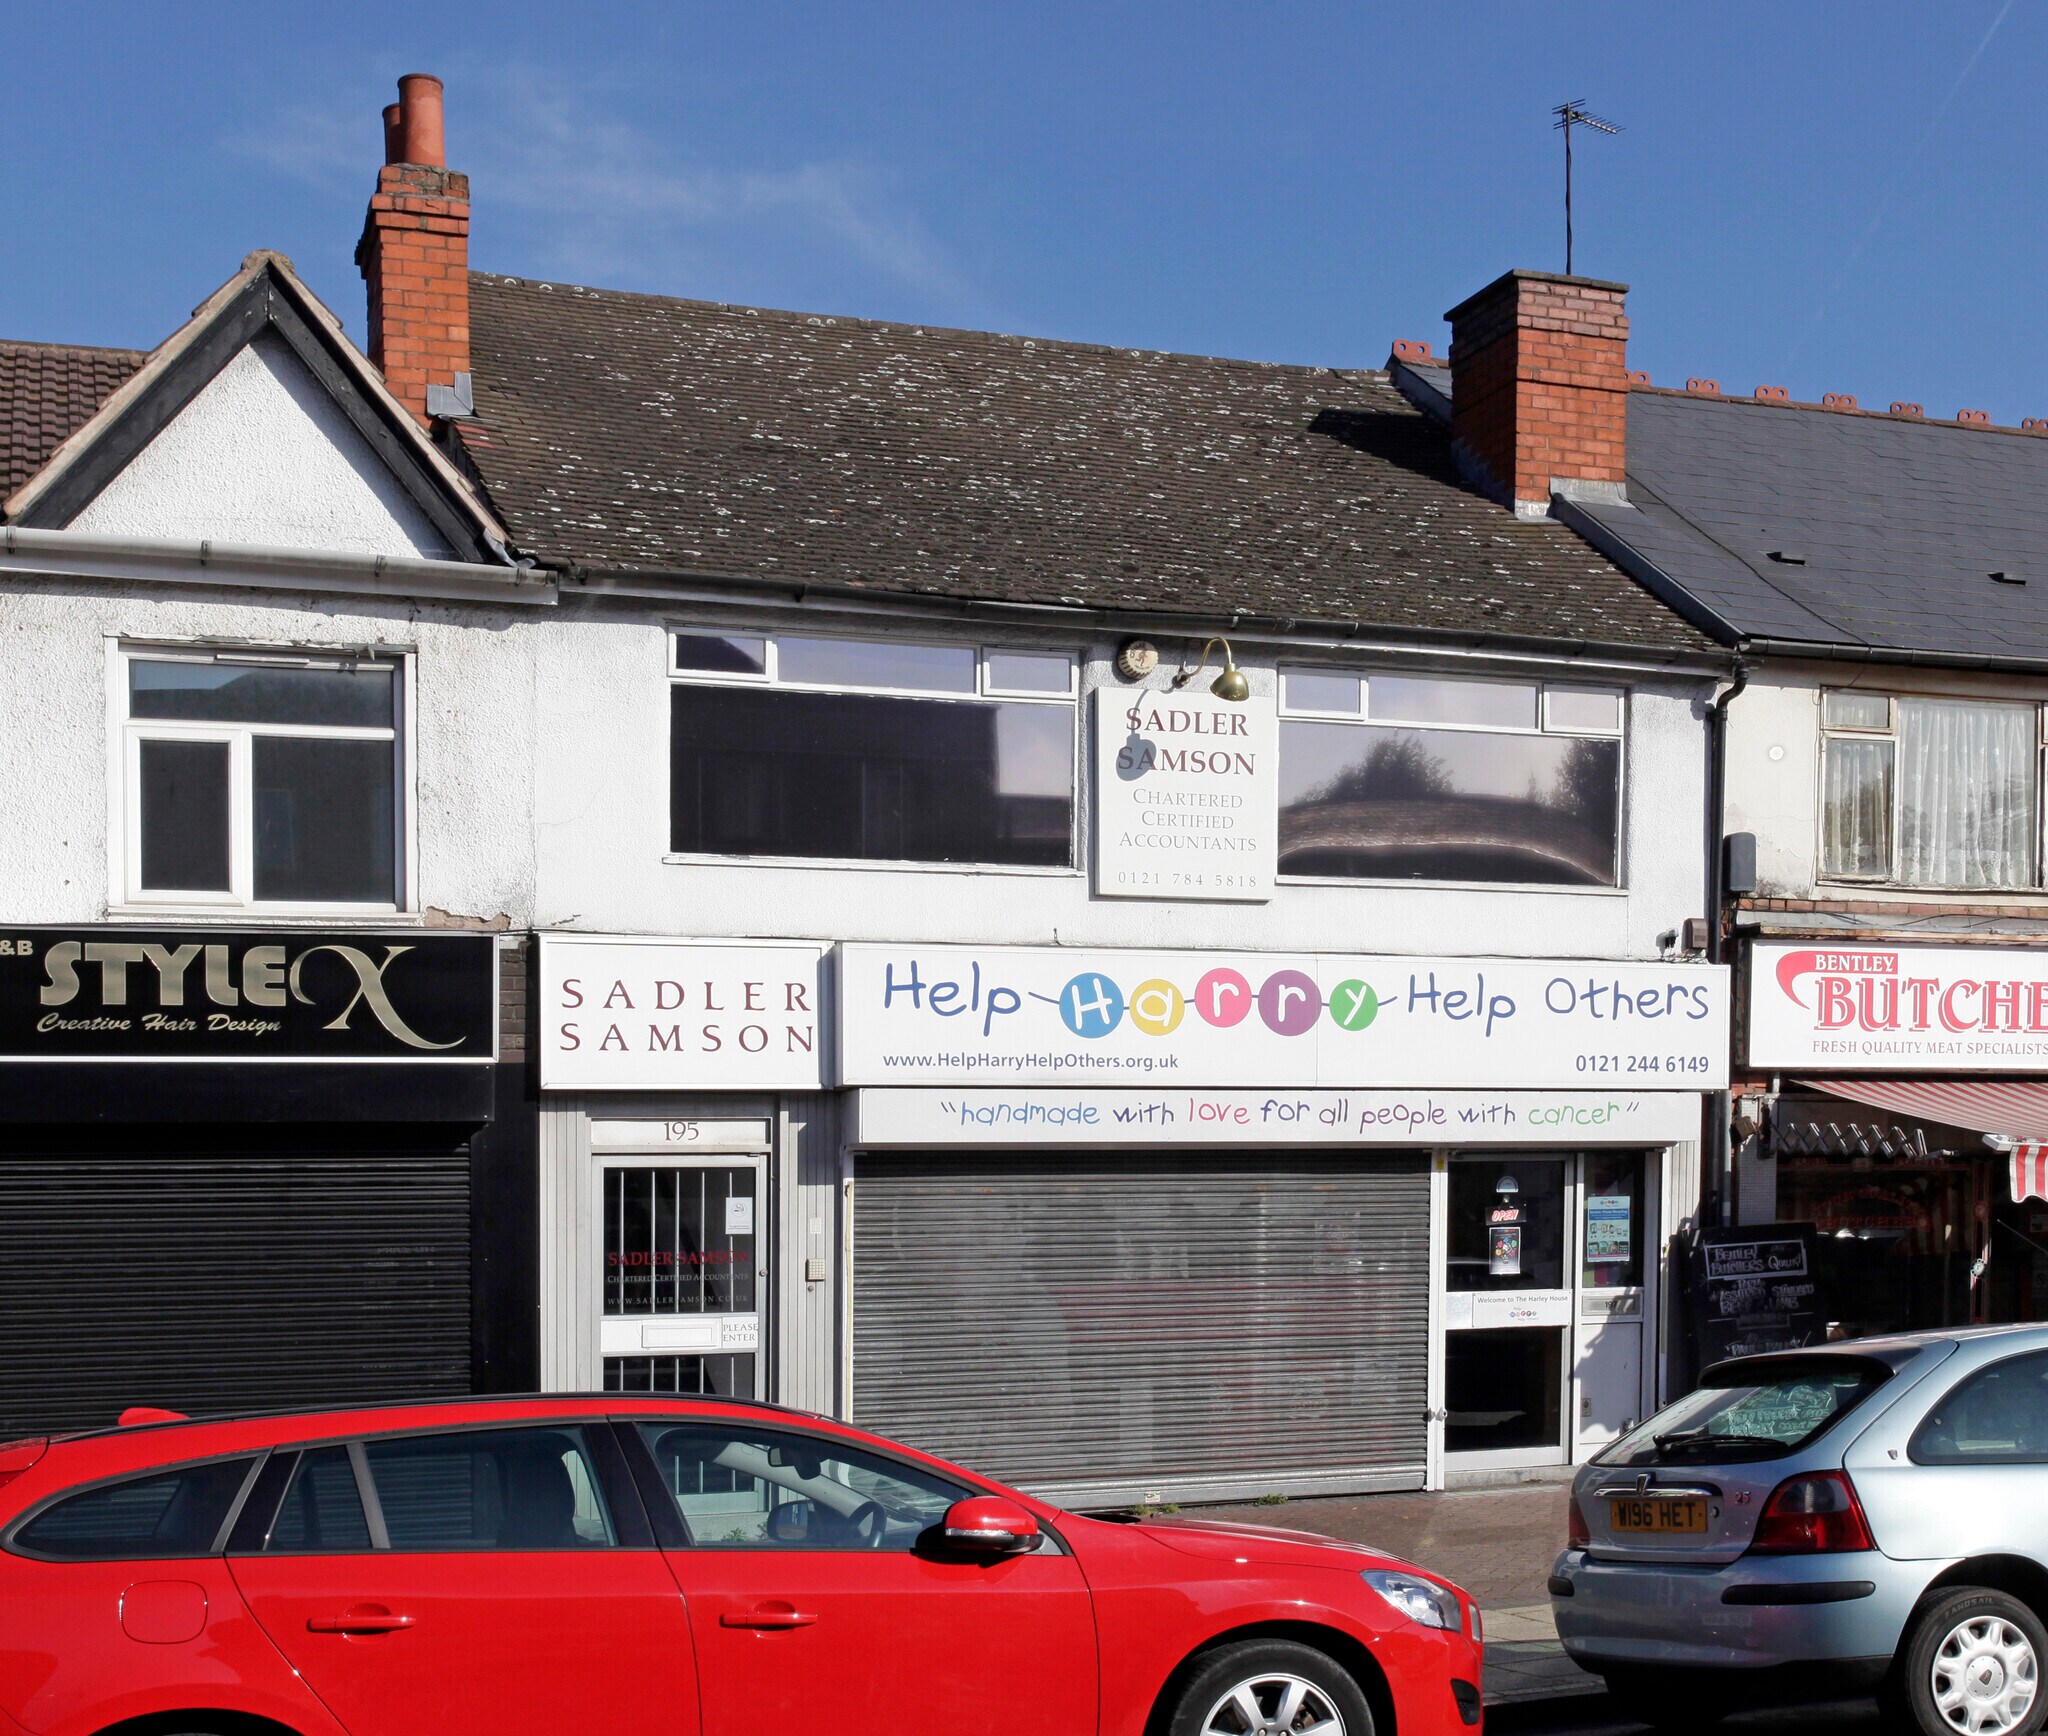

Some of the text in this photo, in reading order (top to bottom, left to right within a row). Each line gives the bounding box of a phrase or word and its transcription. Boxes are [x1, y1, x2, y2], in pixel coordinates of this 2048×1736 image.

[1126, 707, 1249, 737] SADLER
[1117, 746, 1256, 776] SAMSON
[1118, 871, 1257, 888] 0121 784 5818
[1815, 954, 1895, 973] BENTLEY
[561, 978, 812, 1012] SADLER
[884, 960, 1021, 1037] Help
[1408, 972, 1517, 1038] Help
[1545, 977, 1709, 1021] Others
[37, 1012, 282, 1037] Creative Hair Design
[559, 1022, 814, 1053] SAMSON
[1812, 1040, 2048, 1056] FRESH QUALITY MEAT SPECIALISTS
[883, 1051, 1179, 1072] www.HelpHarryHelpOthers.org.uk
[1575, 1054, 1709, 1073] 0121 244 6149
[1112, 1101, 1175, 1126] with
[1188, 1097, 1251, 1125] love
[1259, 1098, 1311, 1123] for
[1318, 1097, 1349, 1127] all
[1359, 1098, 1448, 1135] people
[1458, 1102, 1516, 1126] with
[663, 1120, 700, 1141] 195
[1491, 1208, 1519, 1222] OPEN
[607, 1249, 750, 1267] SADLER SAMSON
[607, 1274, 652, 1284] CHRTERED
[655, 1273, 692, 1282] CERTIIED
[1477, 1296, 1506, 1304] Welcome
[1605, 1301, 1618, 1309] 197
[723, 1323, 759, 1333] PLEASE
[723, 1333, 756, 1342] ENTER
[1617, 1501, 1697, 1527] W196 HET
